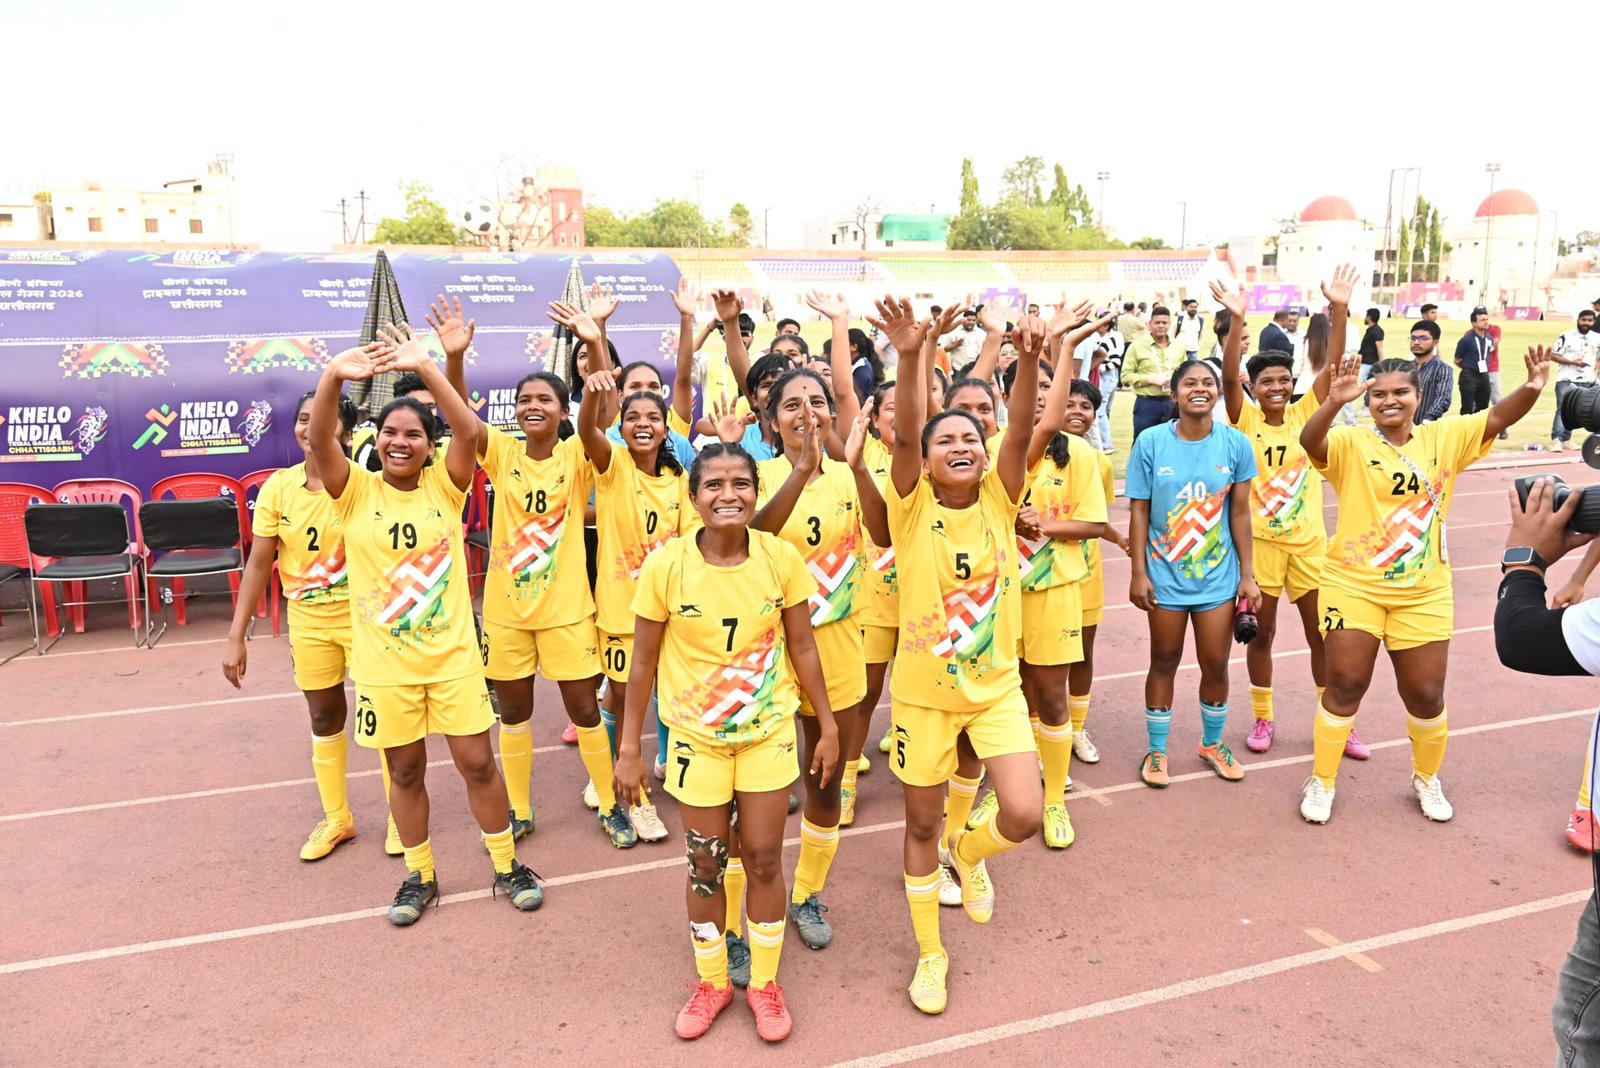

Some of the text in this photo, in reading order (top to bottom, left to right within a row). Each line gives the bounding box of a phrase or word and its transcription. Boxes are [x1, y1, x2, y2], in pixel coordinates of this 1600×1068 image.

[49, 289, 84, 298] 2026
[215, 288, 248, 296] 2026
[507, 284, 535, 292] 2026
[639, 284, 665, 292] 2026
[8, 406, 71, 424] KHELO
[180, 400, 239, 419] KHELO
[487, 405, 516, 421] IND
[8, 424, 63, 441] INDIA
[180, 418, 232, 437] INDIA
[8, 445, 75, 454] CHHATTISGARH
[1264, 446, 1287, 467] 17
[1175, 480, 1207, 503] 40
[1391, 472, 1420, 496] 24
[524, 489, 546, 514] 18
[644, 509, 657, 535] 0
[806, 516, 820, 546] 3
[306, 526, 319, 552] 2
[388, 522, 416, 550] 19
[955, 552, 970, 580] 5
[722, 618, 738, 652] 7
[605, 647, 626, 672] 10
[356, 707, 377, 736] 19
[897, 739, 905, 769] 5
[677, 756, 689, 788] 7
